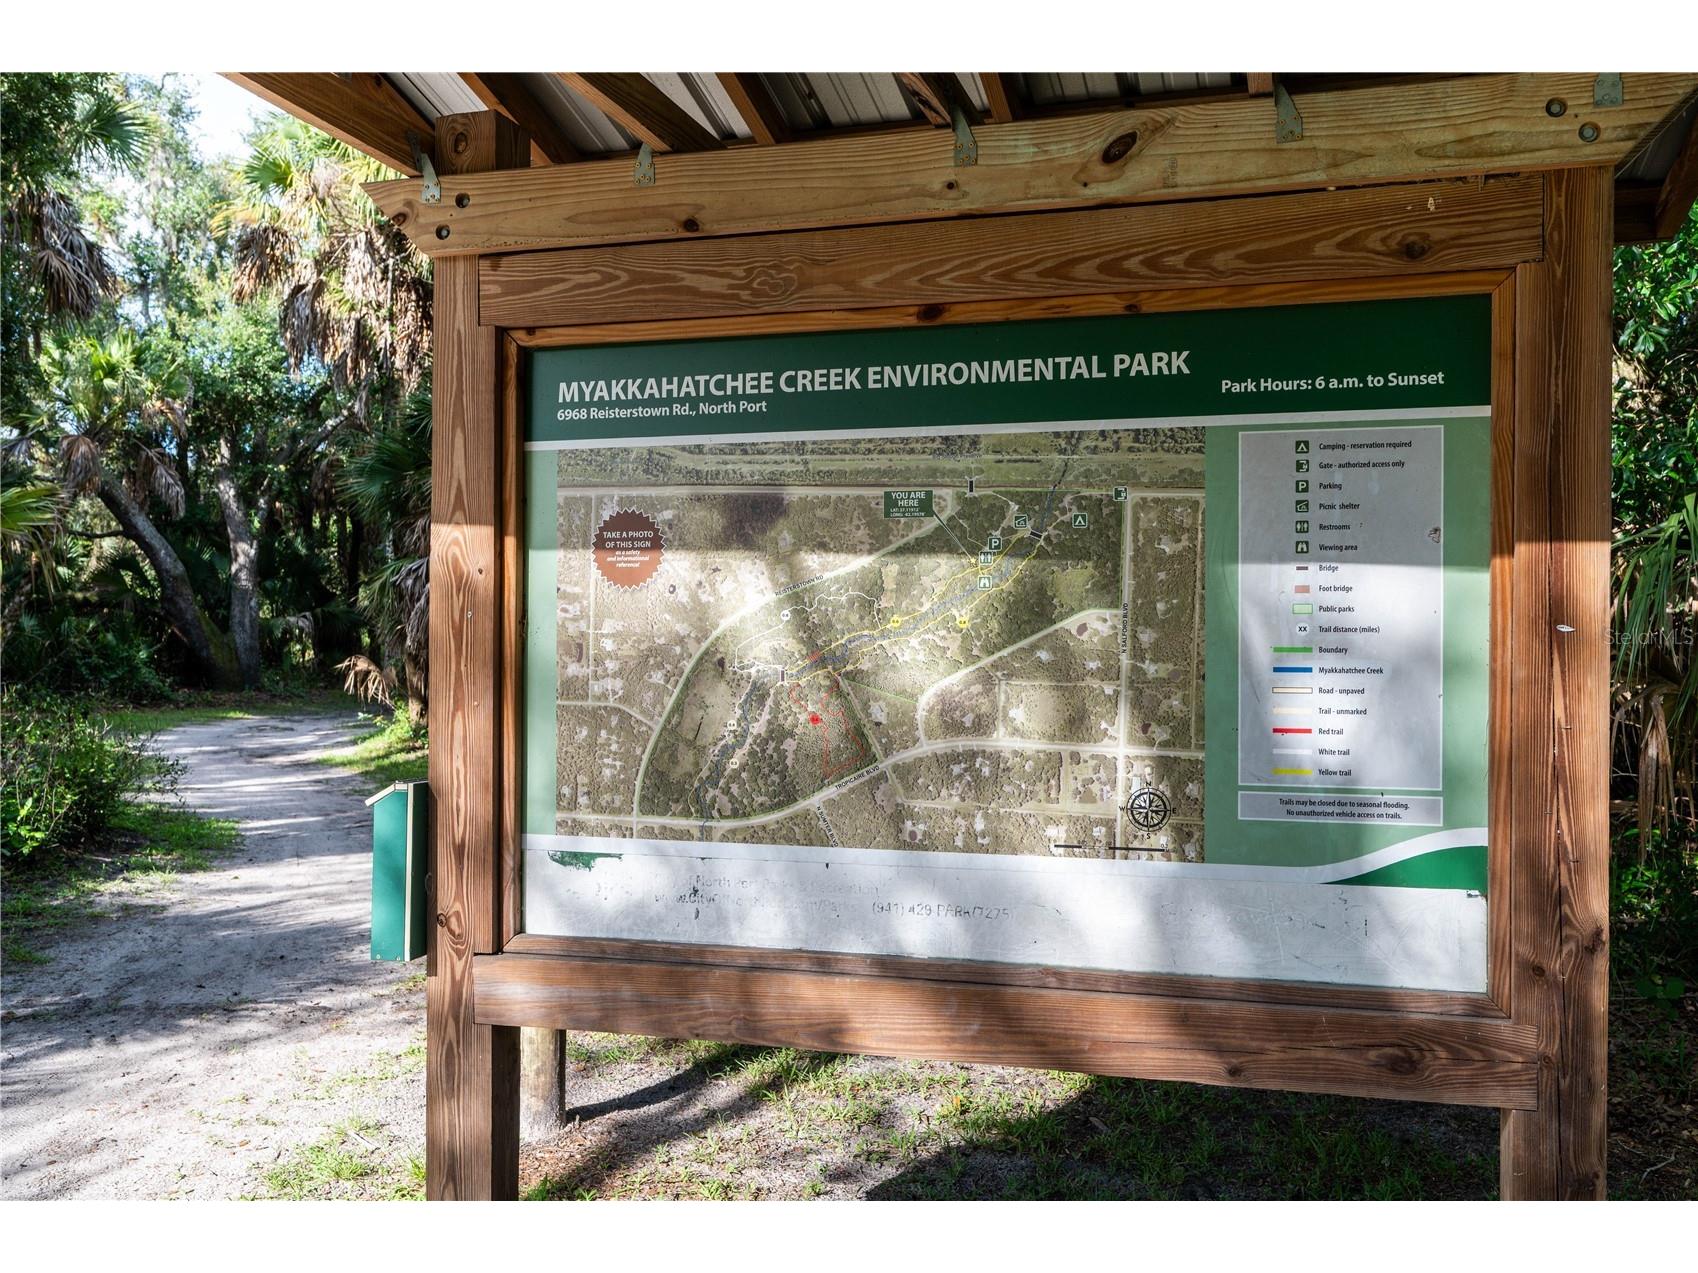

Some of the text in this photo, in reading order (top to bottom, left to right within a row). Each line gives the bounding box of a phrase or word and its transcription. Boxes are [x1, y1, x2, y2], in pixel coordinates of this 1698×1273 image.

[558, 351, 1191, 403] MYAKKAHATCHEE CREEK ENVIRONMENTAL PARK
[1221, 371, 1444, 393] Park Hours: 6 a.m. to Sunset
[557, 400, 767, 420] 6968 Reisterstown Rd., North Port
[1319, 443, 1346, 451] Camping
[1350, 441, 1385, 449] reservation
[1386, 440, 1412, 449] required
[1338, 460, 1371, 468] authorized
[1392, 460, 1405, 468] only
[1299, 482, 1306, 491] P
[1319, 482, 1342, 490] Parking
[891, 491, 926, 499] YOU ARE
[1319, 502, 1360, 510] Picnic shelter
[991, 539, 999, 549] P
[1319, 543, 1343, 552] Viewing
[1333, 585, 1353, 593] bridge
[1338, 605, 1355, 613] parks
[1359, 626, 1380, 634] (miles)
[1319, 646, 1348, 654] Boundary
[1319, 666, 1365, 674] Myakkahatchee
[835, 765, 880, 790] TROPICAIRE BLVD
[1383, 801, 1410, 810] flooding.
[1296, 809, 1334, 817] unauthorized
[1335, 810, 1356, 818] vehicle
